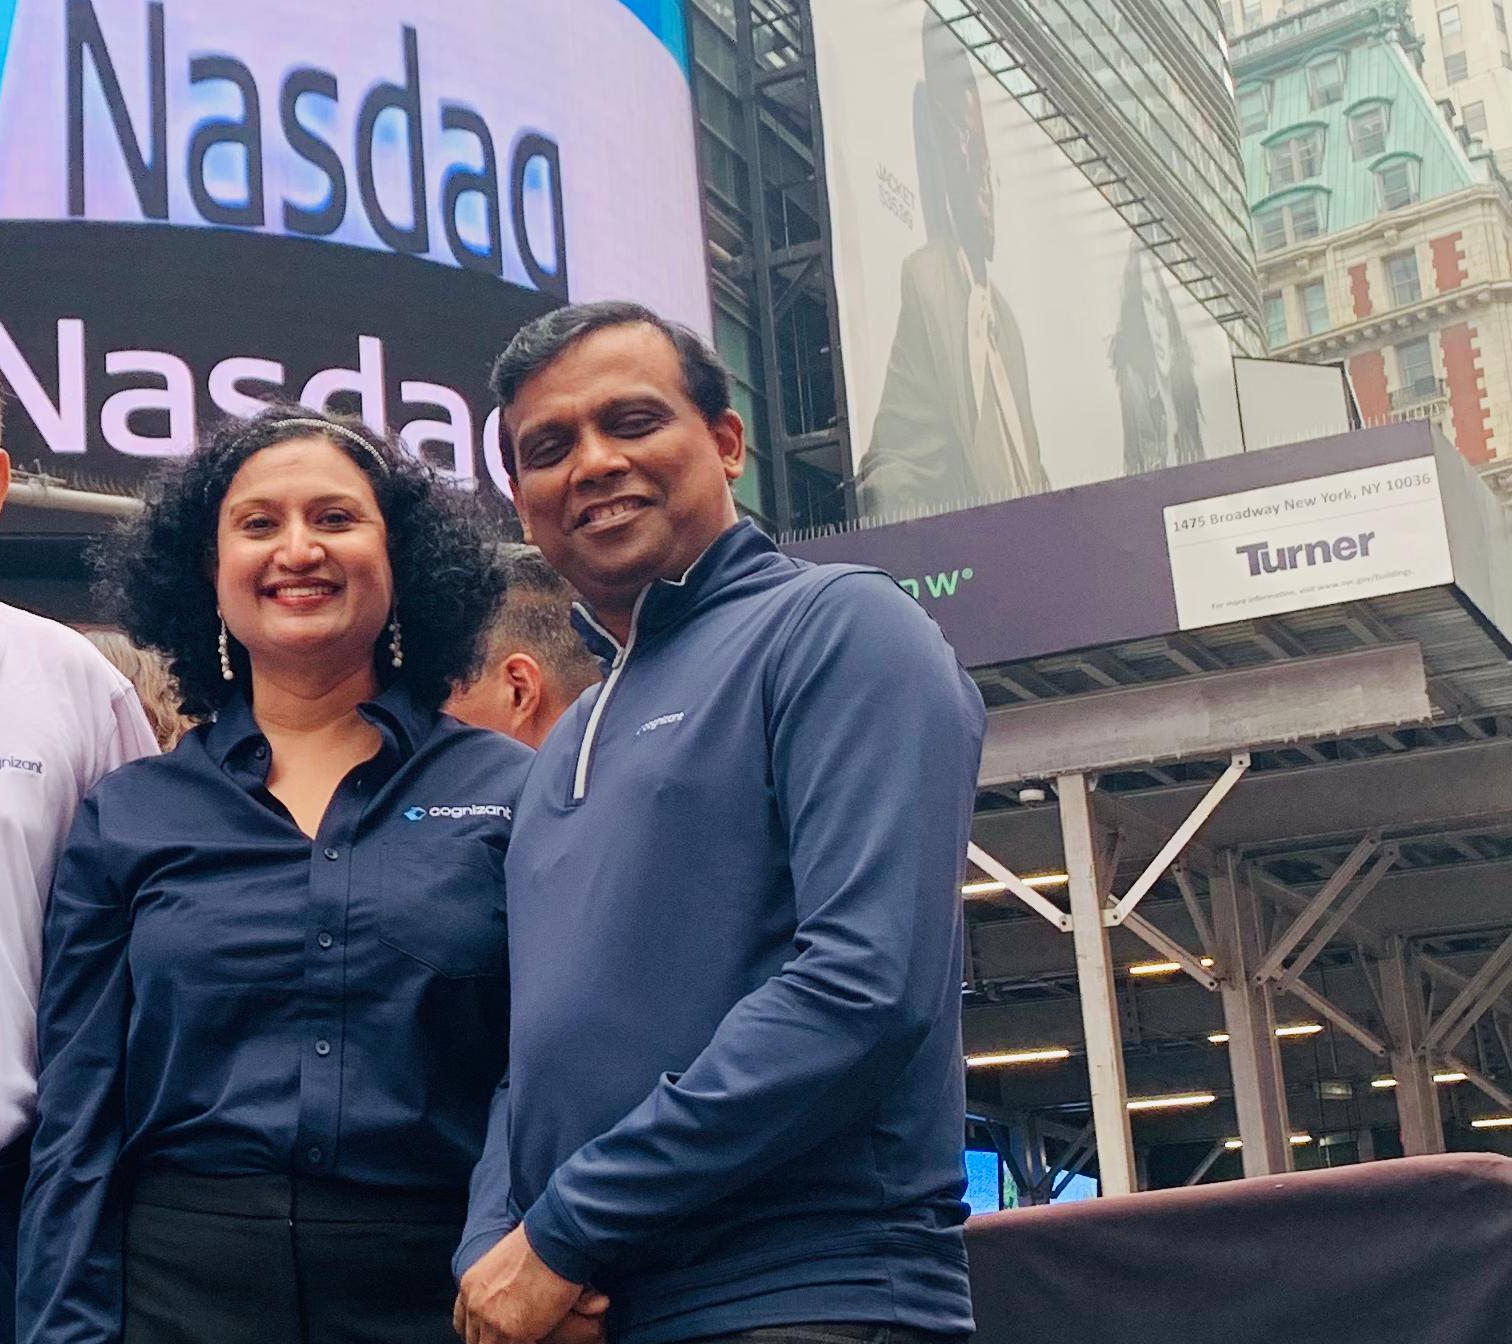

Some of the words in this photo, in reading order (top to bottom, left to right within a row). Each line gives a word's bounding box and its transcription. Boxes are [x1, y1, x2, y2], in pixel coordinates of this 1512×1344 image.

[1173, 517, 1206, 533] 1475
[1210, 504, 1280, 525] Broadway
[1284, 497, 1316, 511] New
[1320, 488, 1357, 504] York,
[1361, 482, 1381, 497] NY
[1387, 473, 1431, 492] 10036
[1236, 531, 1375, 577] Turner
[429, 804, 512, 821] cognizant
